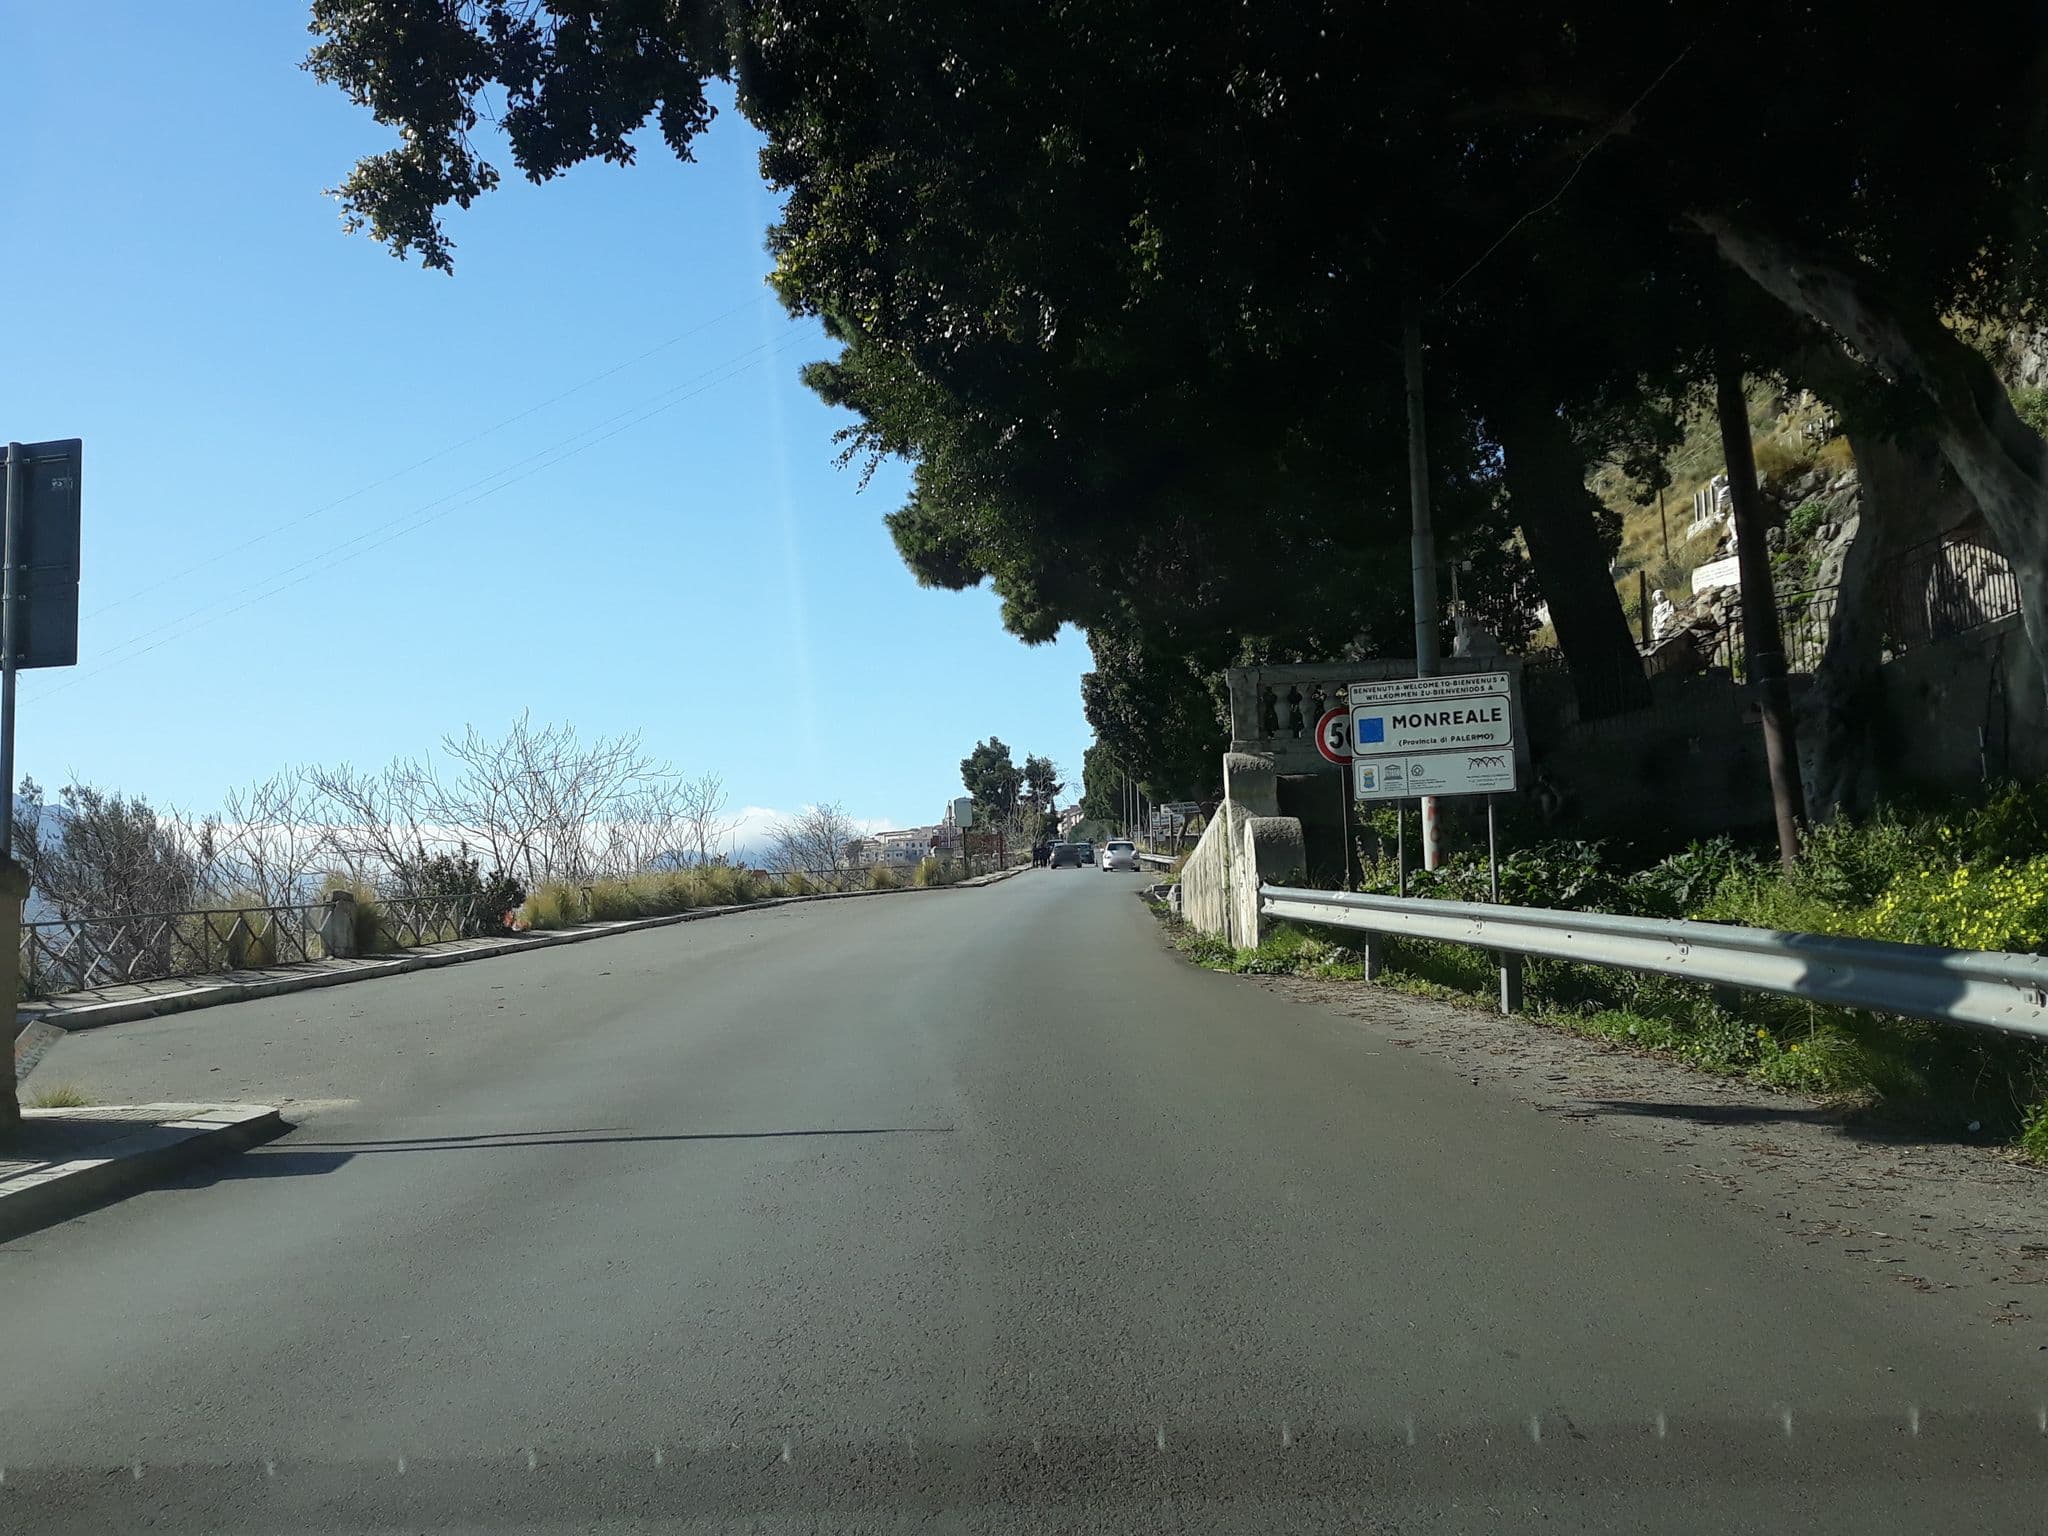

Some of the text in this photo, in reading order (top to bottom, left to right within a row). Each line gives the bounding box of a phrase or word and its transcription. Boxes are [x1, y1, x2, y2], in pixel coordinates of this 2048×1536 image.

[1353, 685, 1394, 694] BENVENUTI
[1365, 691, 1418, 700] WILLKOMMEN
[1392, 708, 1503, 729] MONREALE
[1398, 733, 1495, 747] (Provincia di PALERMO)
